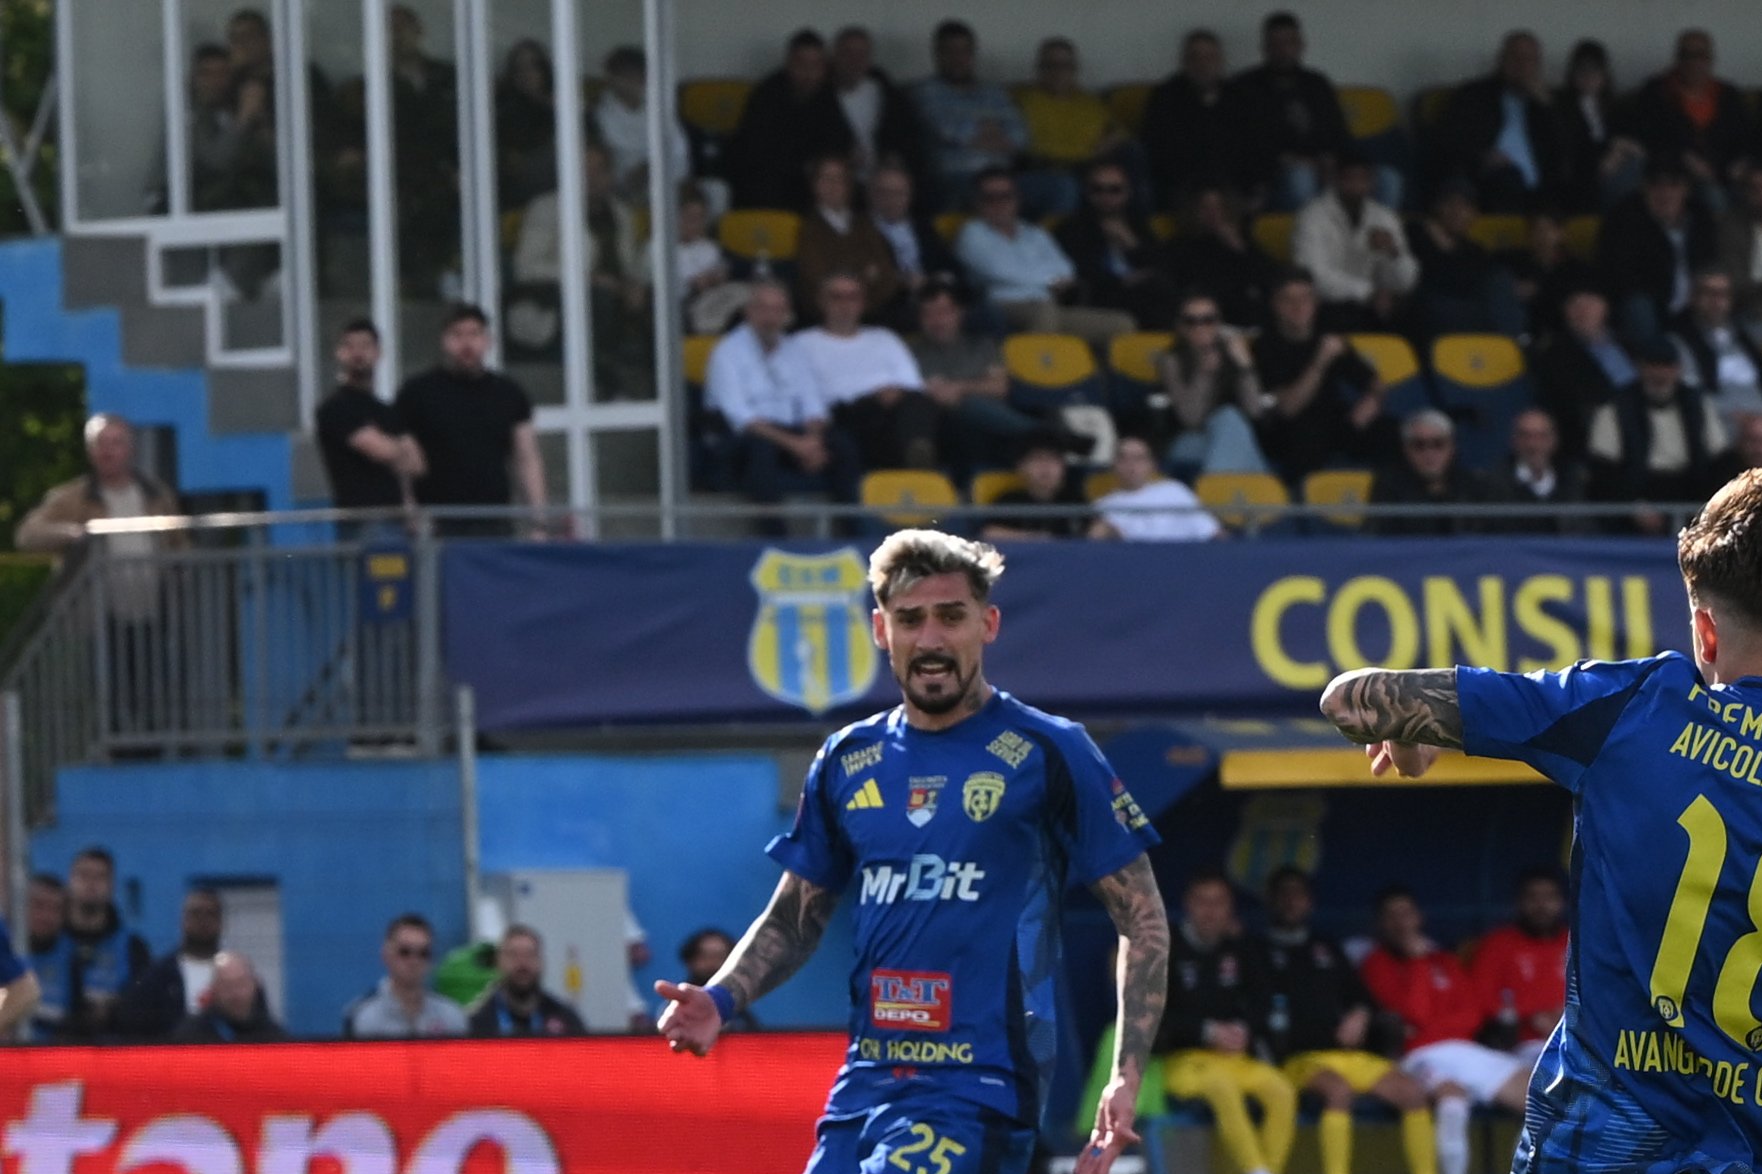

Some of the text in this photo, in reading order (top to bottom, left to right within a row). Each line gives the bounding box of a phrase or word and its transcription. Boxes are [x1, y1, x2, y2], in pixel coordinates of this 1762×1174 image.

[860, 853, 986, 905] MrBit
[873, 1007, 931, 1023] DEPO
[887, 1039, 974, 1064] HOLDING
[1614, 1029, 1749, 1105] AVANGDE
